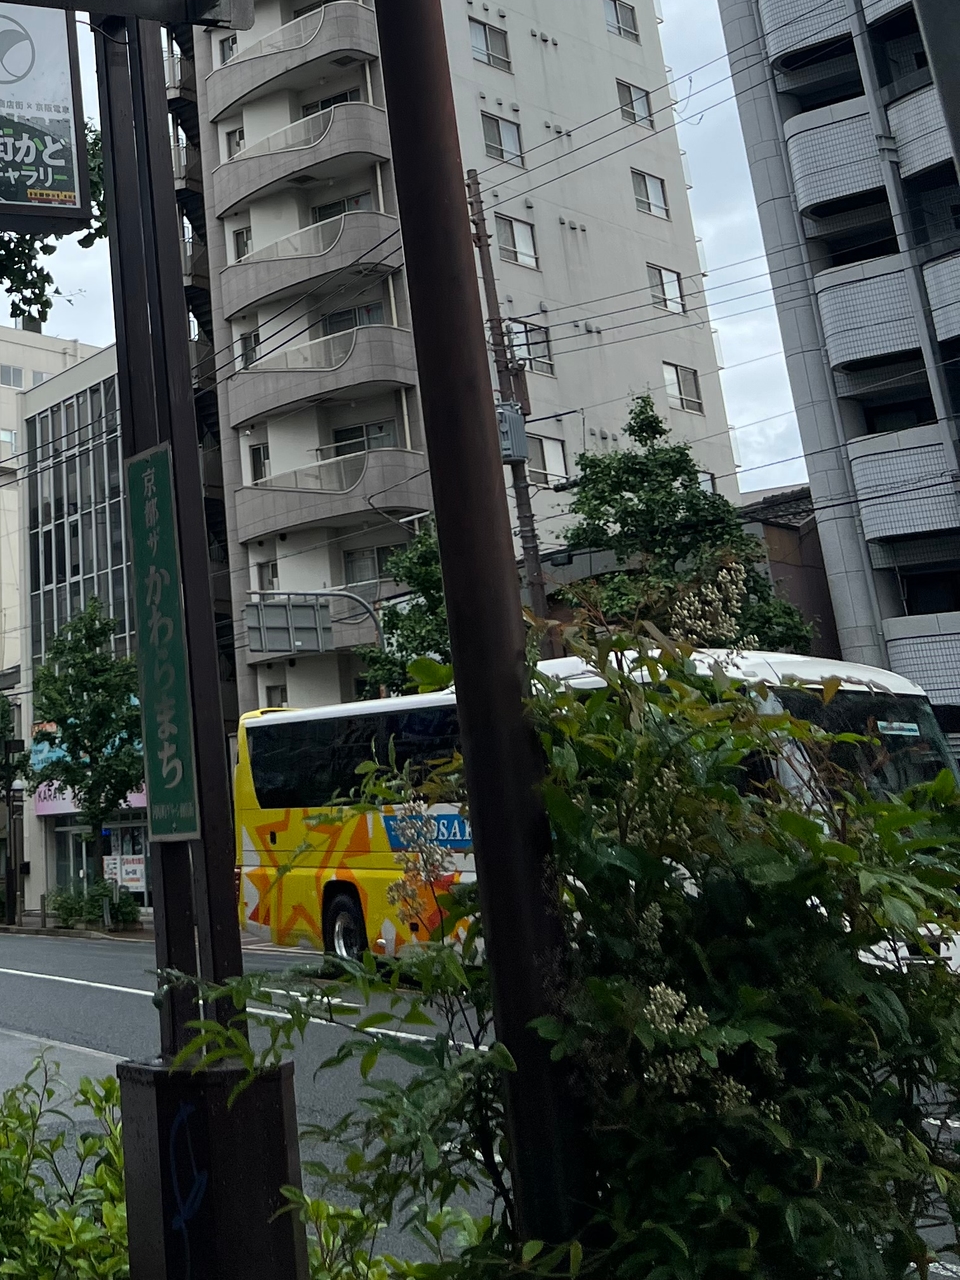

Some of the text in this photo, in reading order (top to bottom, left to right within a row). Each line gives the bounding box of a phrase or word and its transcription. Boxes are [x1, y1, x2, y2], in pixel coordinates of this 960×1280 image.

[145, 565, 183, 789] かわらまち
